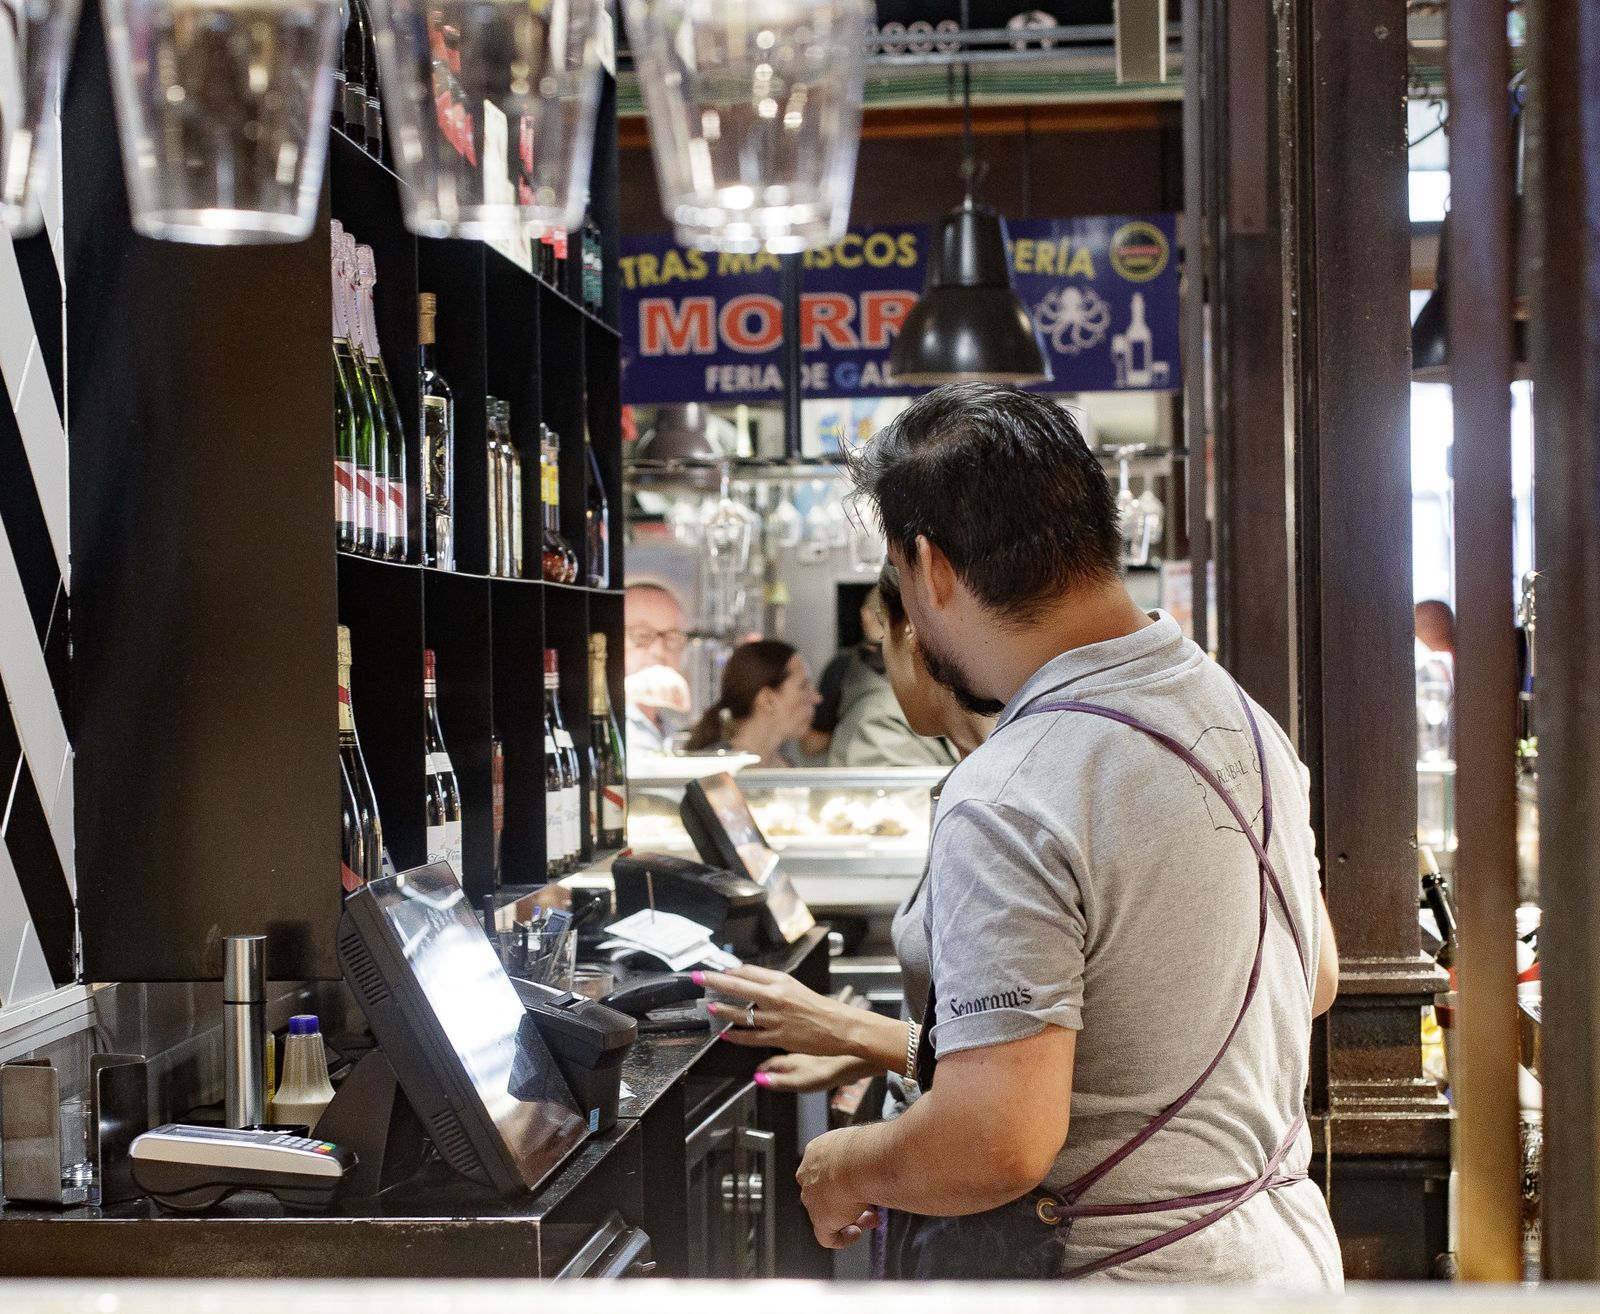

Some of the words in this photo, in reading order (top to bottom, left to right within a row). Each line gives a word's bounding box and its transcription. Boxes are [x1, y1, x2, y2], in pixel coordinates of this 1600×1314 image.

[618, 249, 709, 290] TRAS
[718, 232, 918, 277] MAISCOS
[1008, 236, 1096, 281] ERÍA
[639, 290, 920, 357] MORR
[705, 363, 784, 393] FERIA
[834, 360, 902, 390] GAL
